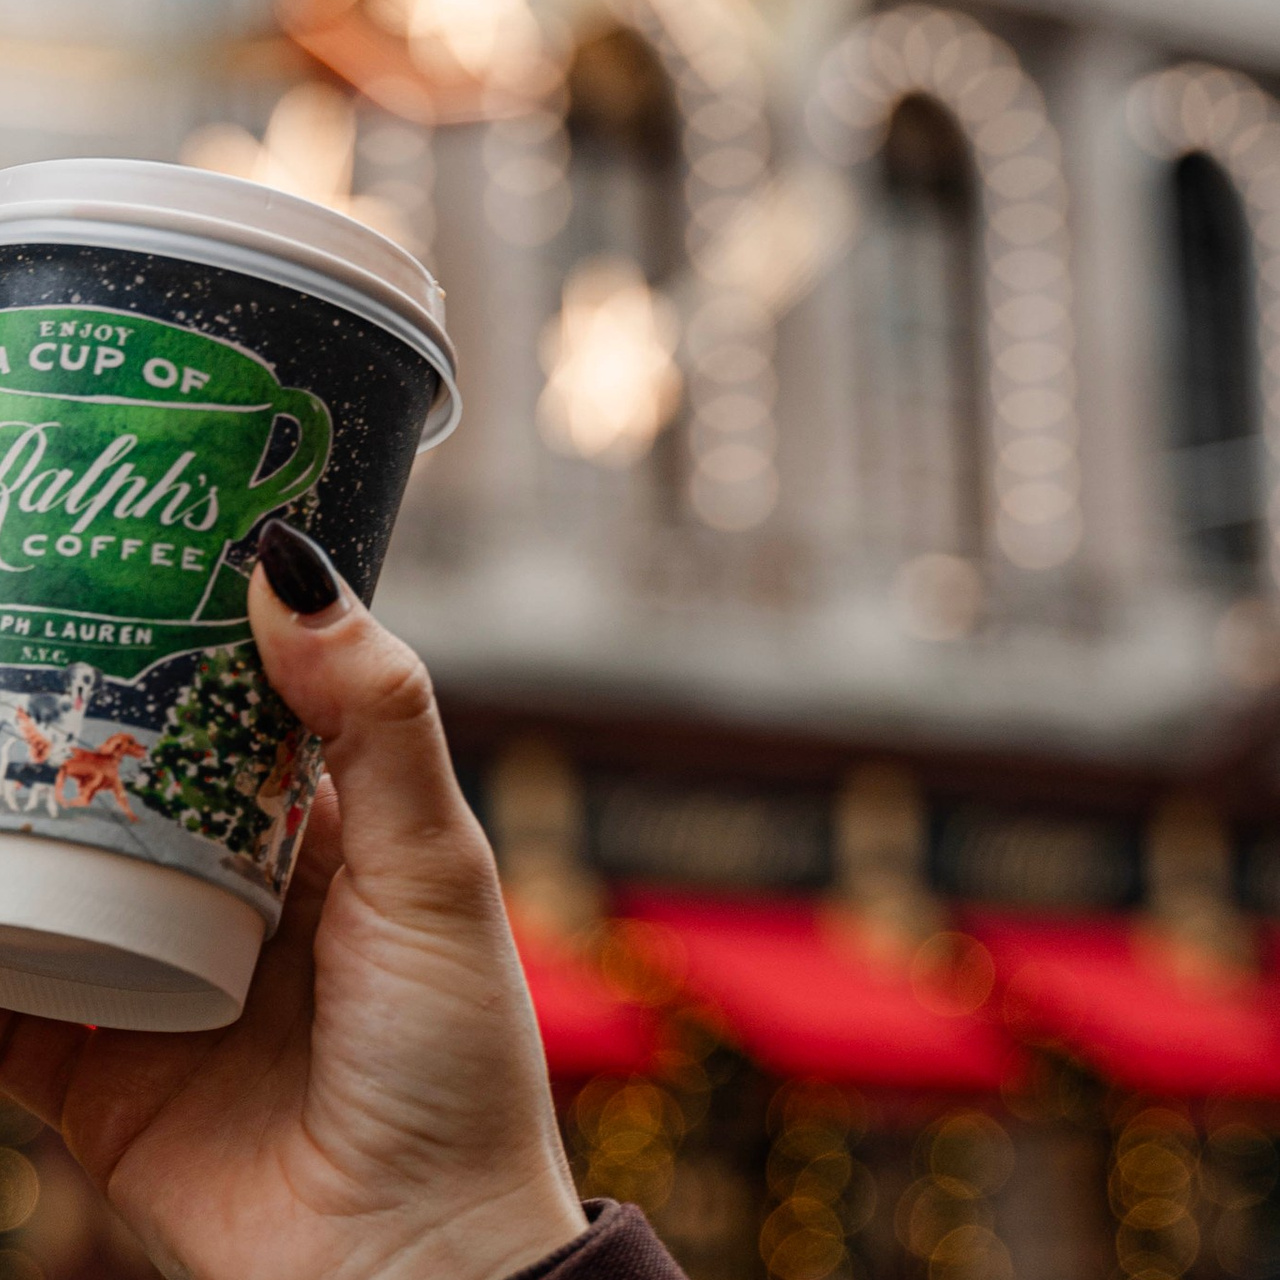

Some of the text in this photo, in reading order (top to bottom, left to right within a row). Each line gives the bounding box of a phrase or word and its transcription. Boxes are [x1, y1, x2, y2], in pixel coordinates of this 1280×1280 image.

[40, 321, 135, 346] ENJOY
[29, 342, 125, 375] CUP
[143, 358, 211, 394] OF
[22, 533, 205, 572] COFFEE
[45, 621, 153, 645] LAUREN
[22, 647, 69, 664] N.Y.C.
